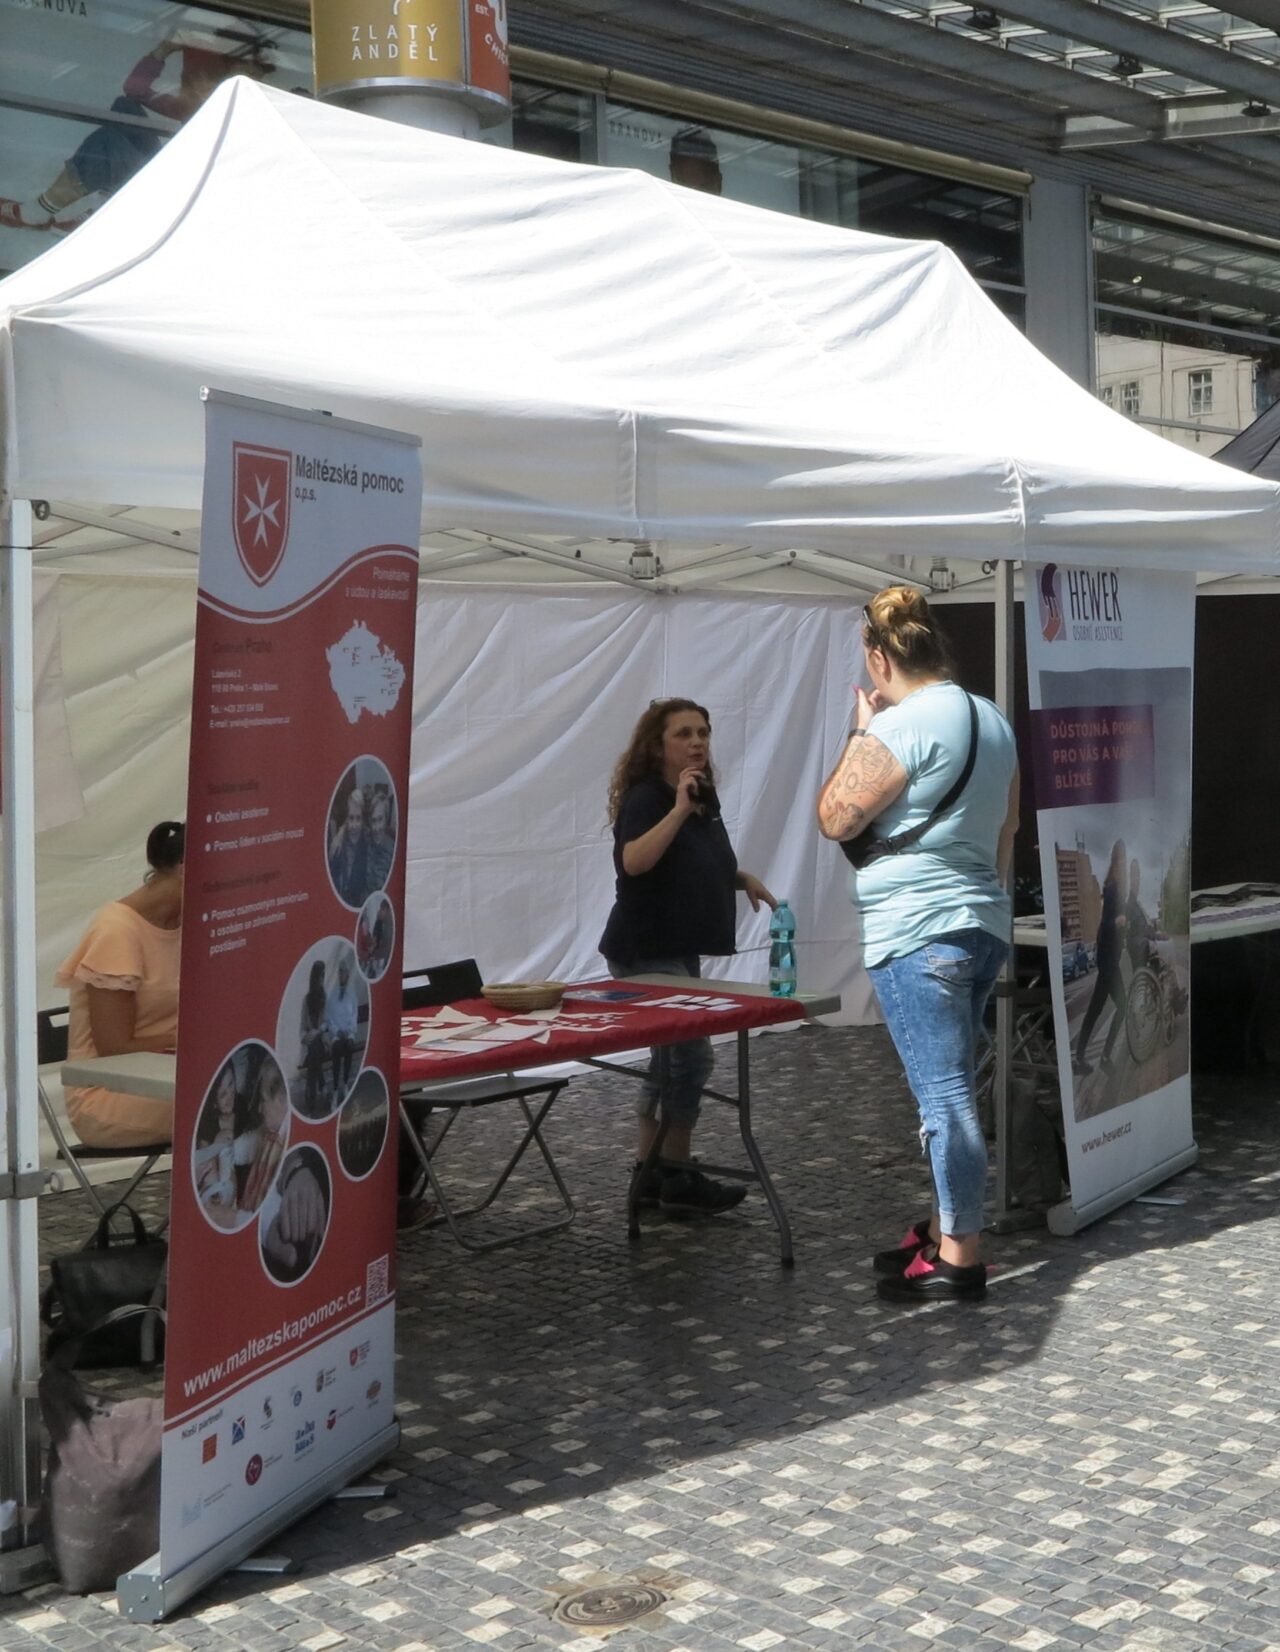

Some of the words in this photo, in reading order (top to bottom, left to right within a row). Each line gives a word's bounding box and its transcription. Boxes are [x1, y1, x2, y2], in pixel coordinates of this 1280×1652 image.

[352, 24, 438, 42] ZLATÝ
[352, 41, 438, 61] ANDĚL
[295, 454, 358, 487] Maltézská
[361, 471, 405, 495] pomoc
[295, 486, 317, 503] o.p.s.
[1068, 570, 1122, 622] HEWER
[1051, 719, 1109, 739] DŮSTOJNÁ
[1053, 750, 1077, 765] PRO
[1102, 749, 1110, 761] A
[1055, 773, 1093, 789] BLÍZKÉ
[184, 1286, 362, 1398] www.maltezskapomoc.cz
